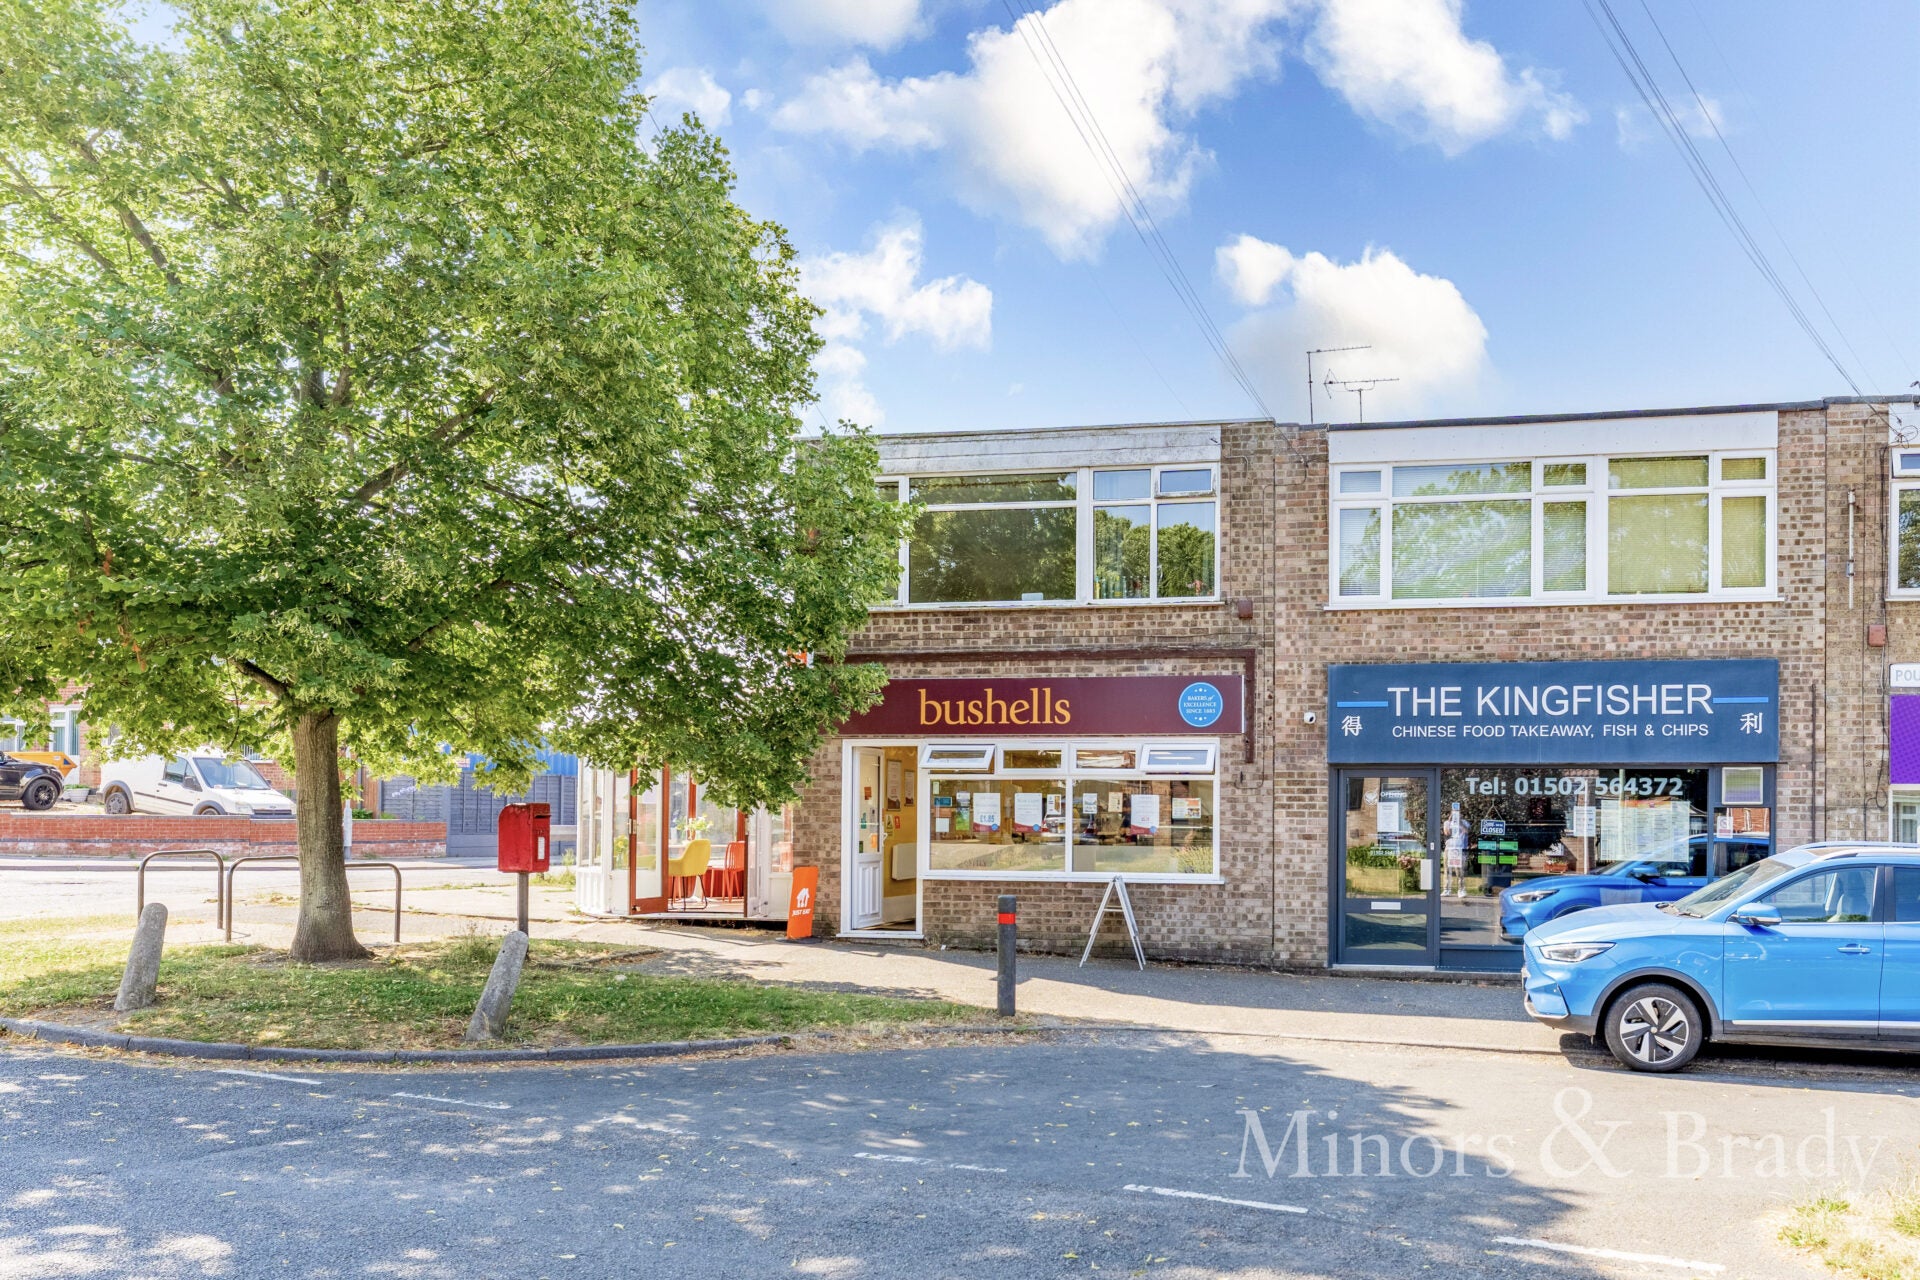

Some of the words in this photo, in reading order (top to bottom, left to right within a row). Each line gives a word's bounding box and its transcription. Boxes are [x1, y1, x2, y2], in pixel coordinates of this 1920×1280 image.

[917, 687, 1071, 726] bushells
[1387, 686, 1463, 717] THE
[1477, 684, 1714, 717] KINGFISHER
[1341, 715, 1364, 737] 得
[1392, 725, 1457, 738] CHINESE
[1463, 725, 1506, 738] FOOD
[1510, 724, 1595, 739] TAKEAWAY,
[1603, 724, 1638, 737] FISH
[1644, 724, 1655, 737] &
[1661, 724, 1709, 737] CHIPS
[1739, 712, 1764, 735] 利
[1465, 777, 1506, 796] Tel:
[1515, 776, 1586, 796] 01502
[1594, 776, 1684, 796] 564372
